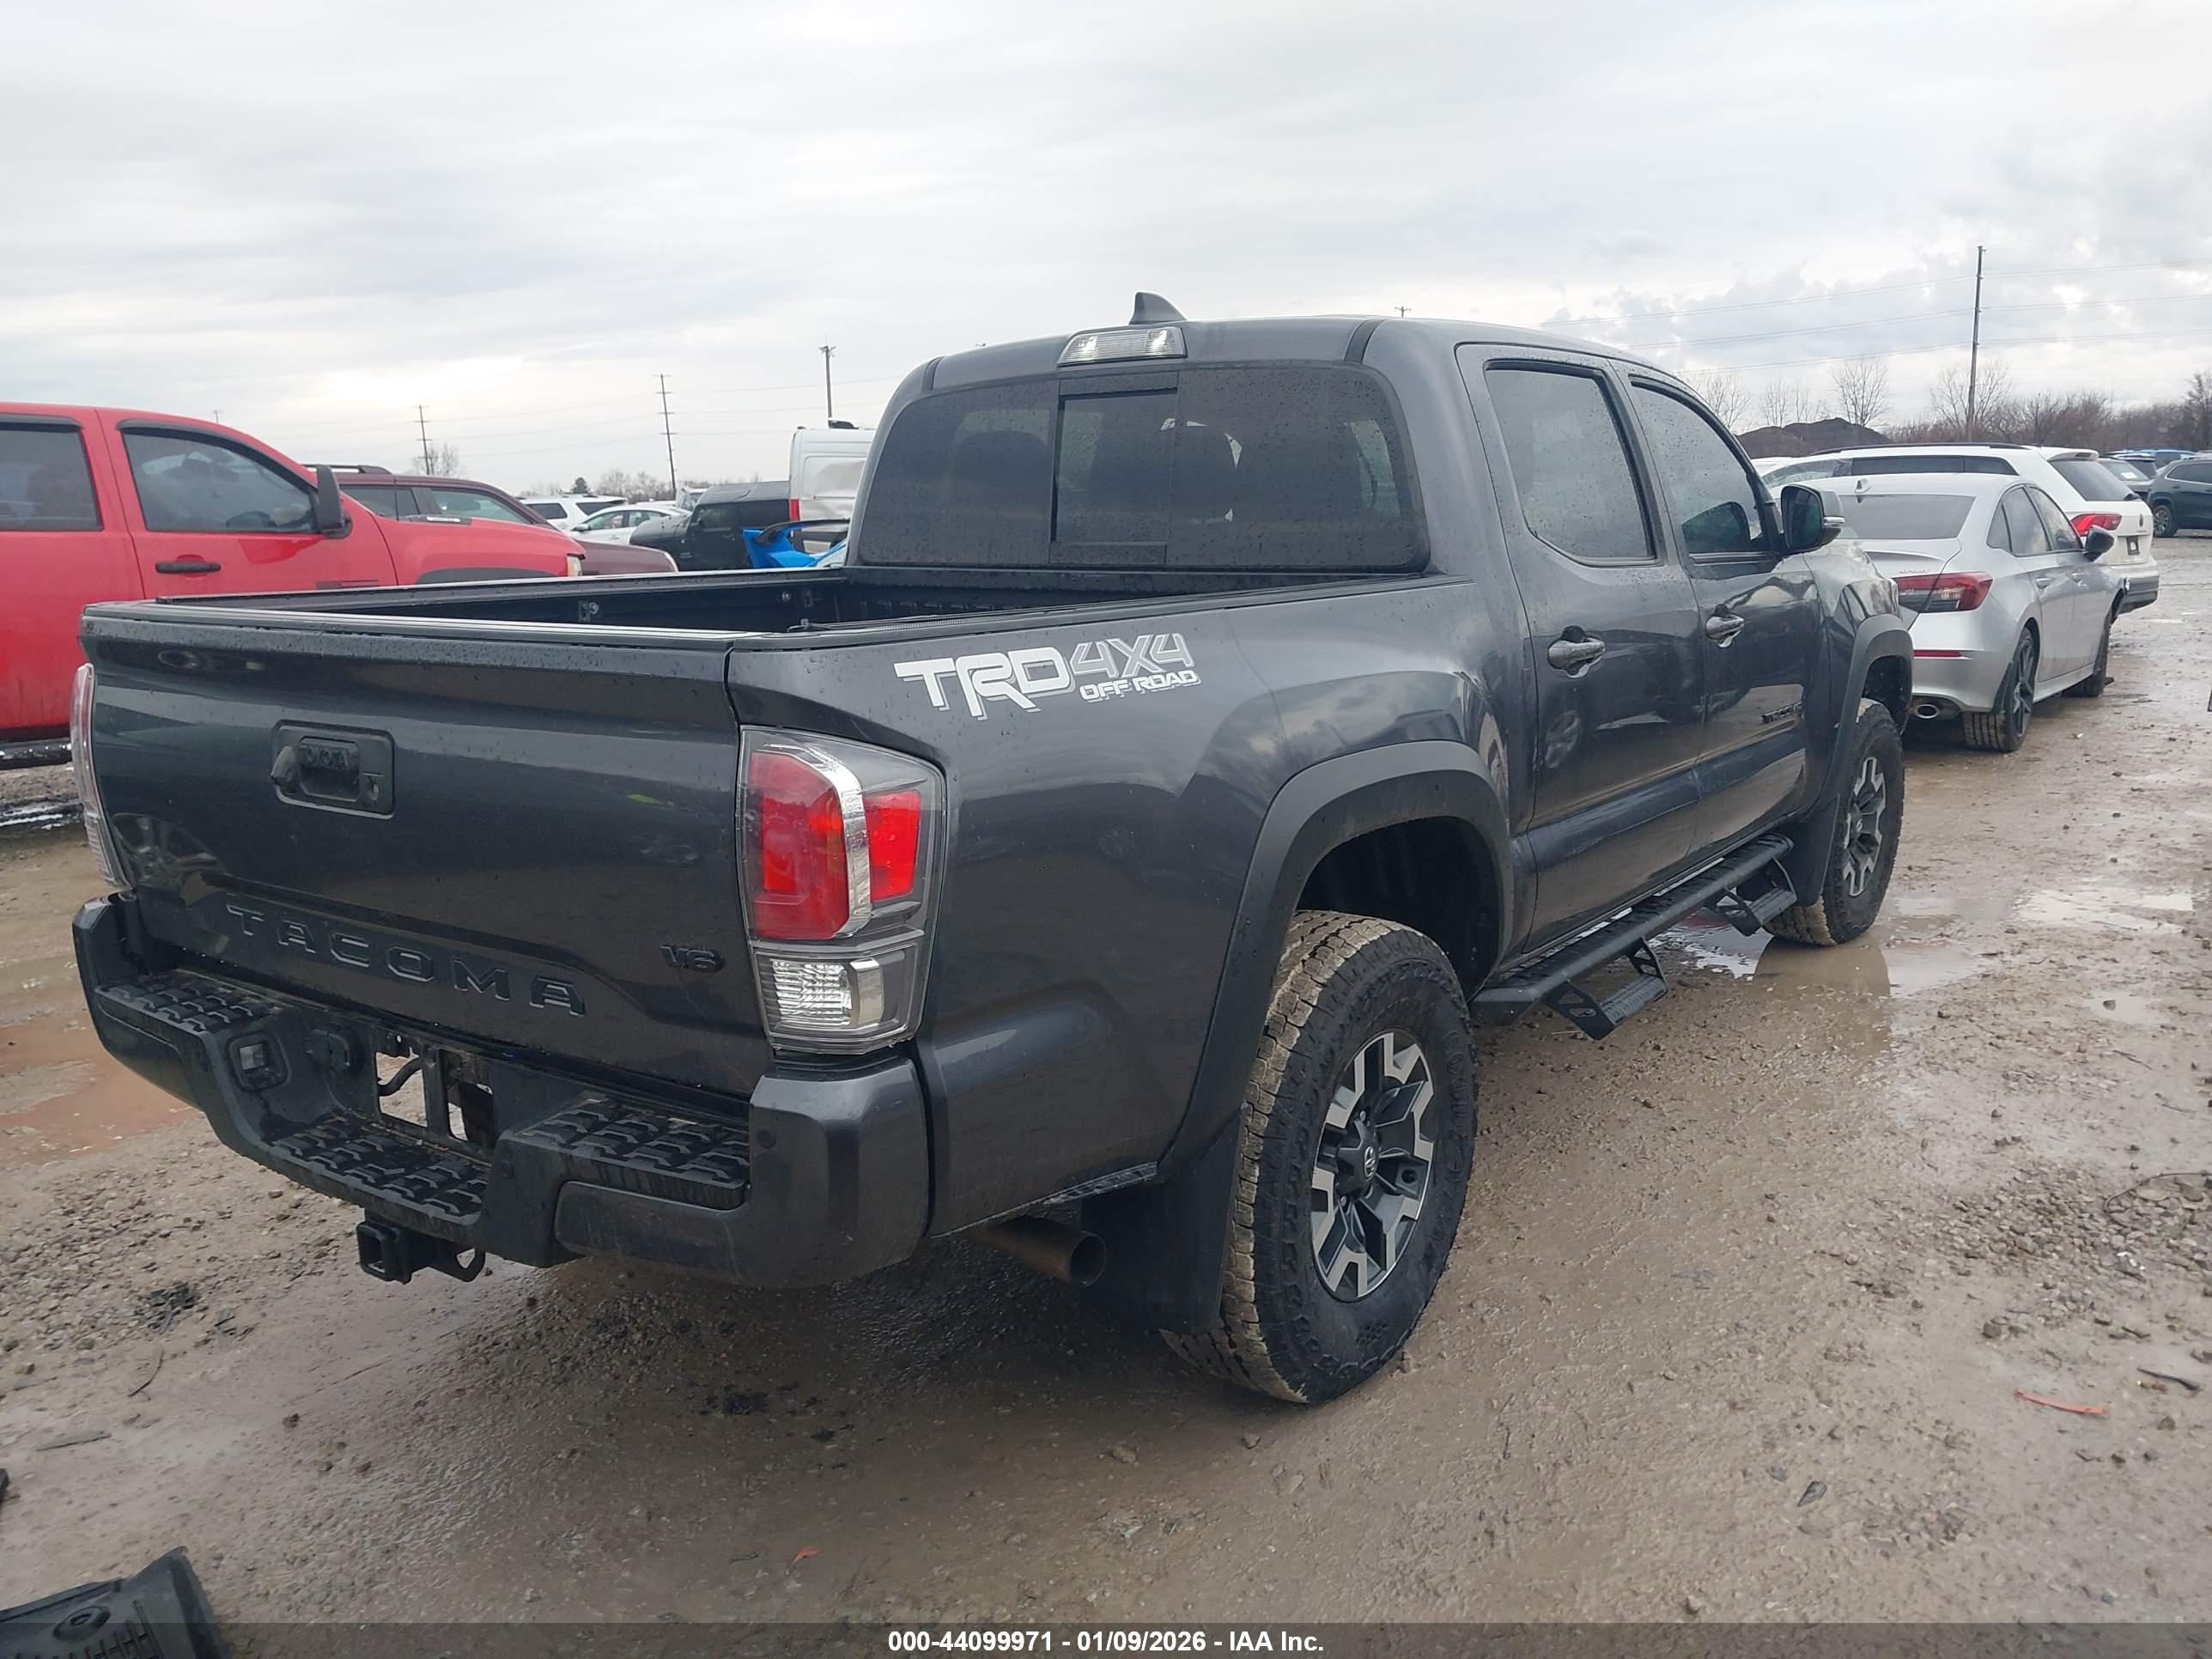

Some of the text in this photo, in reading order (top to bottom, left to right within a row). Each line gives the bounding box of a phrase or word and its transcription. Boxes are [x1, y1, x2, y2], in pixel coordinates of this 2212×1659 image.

[894, 647, 1074, 720] TRD
[1079, 670, 1201, 702] OFF ROAD
[225, 902, 586, 1017] TACOMA
[659, 945, 726, 972] V6
